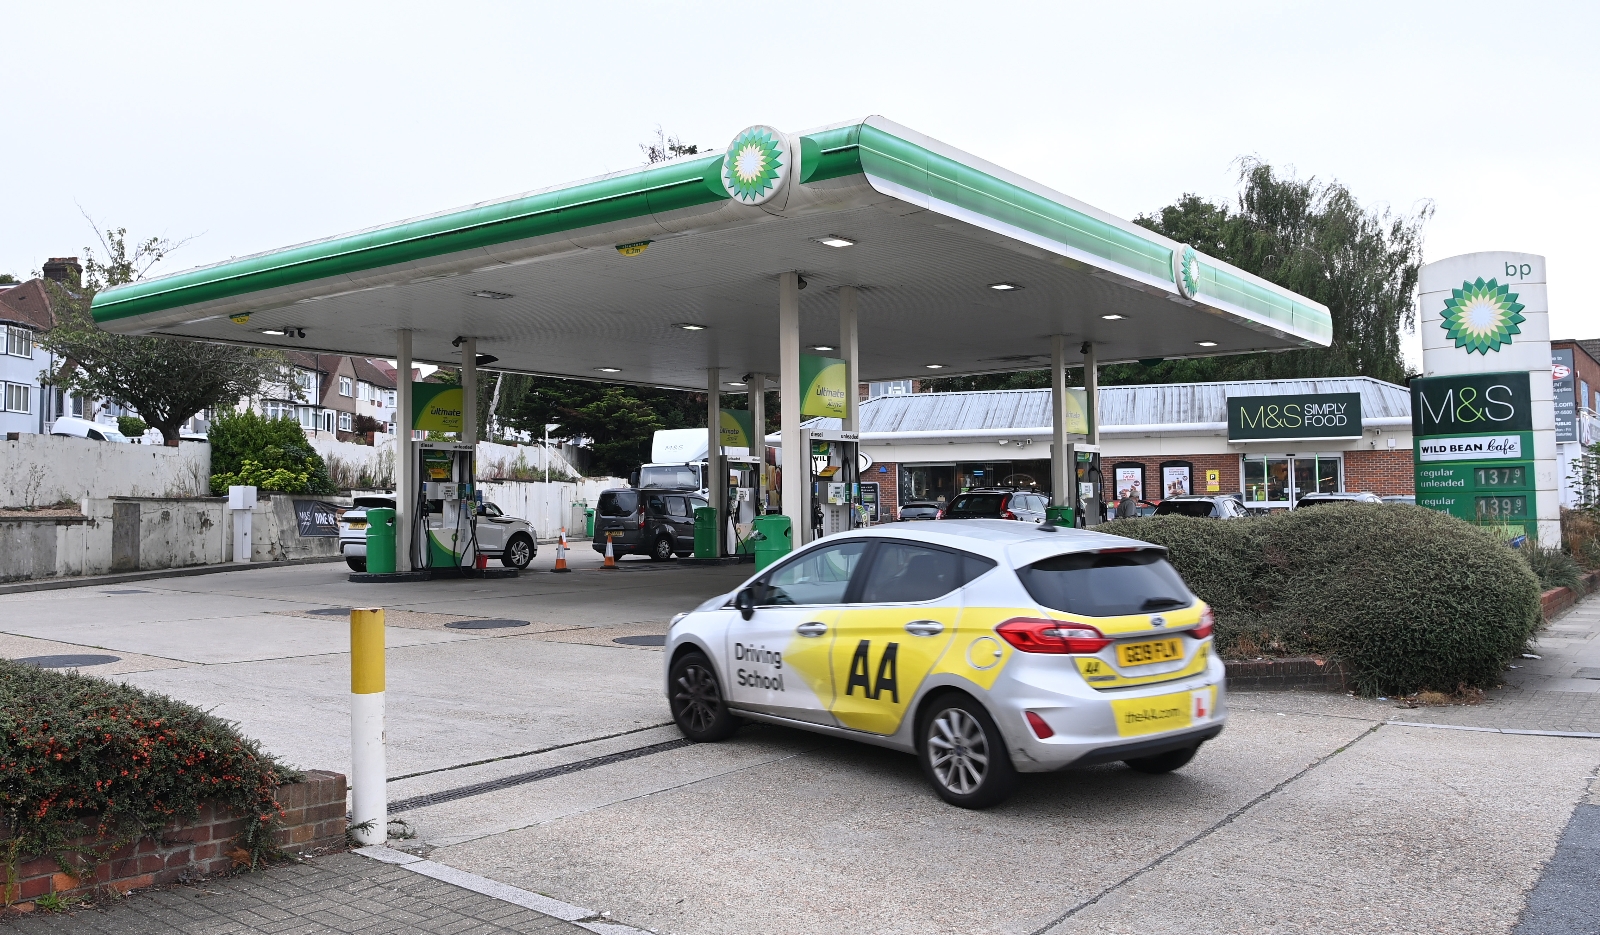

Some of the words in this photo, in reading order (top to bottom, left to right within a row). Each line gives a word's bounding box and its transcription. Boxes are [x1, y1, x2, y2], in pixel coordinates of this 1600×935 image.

[1504, 261, 1532, 281] bp
[816, 386, 845, 399] ultimate
[1304, 402, 1347, 415] SIMPLY
[1419, 384, 1515, 425] M&S
[430, 407, 461, 417] ultimate
[1240, 404, 1302, 429] M&S
[1304, 414, 1347, 427] FOOD
[1421, 445, 1447, 454] WILD
[1449, 443, 1483, 453] BEAN
[1420, 468, 1454, 478] regular
[1420, 479, 1465, 488] unleaded
[1421, 497, 1456, 507] regular
[734, 642, 782, 669] Driving
[845, 639, 900, 703] AA
[736, 668, 785, 692] School
[1196, 697, 1207, 719] L
